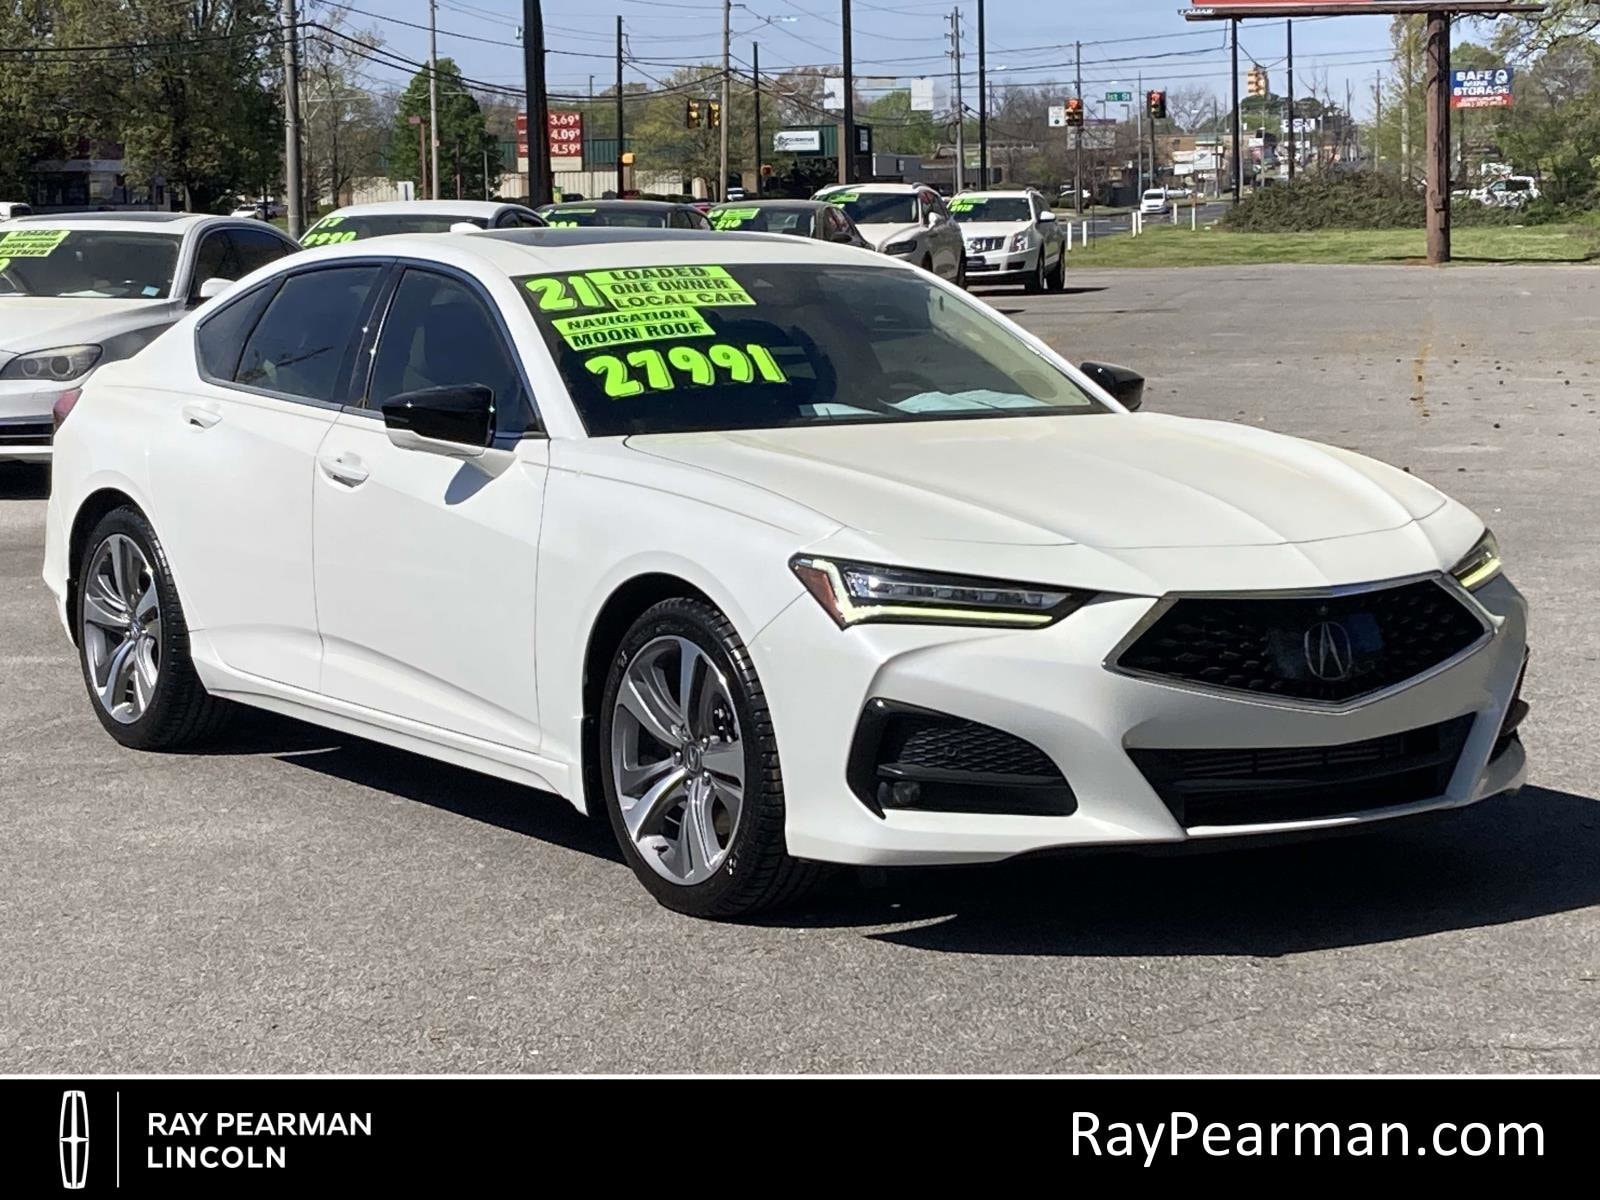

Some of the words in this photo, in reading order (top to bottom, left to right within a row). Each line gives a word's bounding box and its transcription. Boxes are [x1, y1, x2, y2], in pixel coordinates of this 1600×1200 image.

[1456, 70, 1492, 81] SAFE
[1454, 85, 1509, 96] STORAGE
[525, 275, 605, 312] 21
[609, 266, 710, 281] LOADED
[611, 281, 653, 295] ONE
[658, 278, 730, 293] OWNER
[616, 293, 694, 309] LOCAL
[698, 290, 748, 305] CAR
[567, 308, 688, 331] NAVIGATION
[573, 328, 643, 348] MOON
[647, 322, 707, 338] ROOF
[585, 344, 787, 399] 27991
